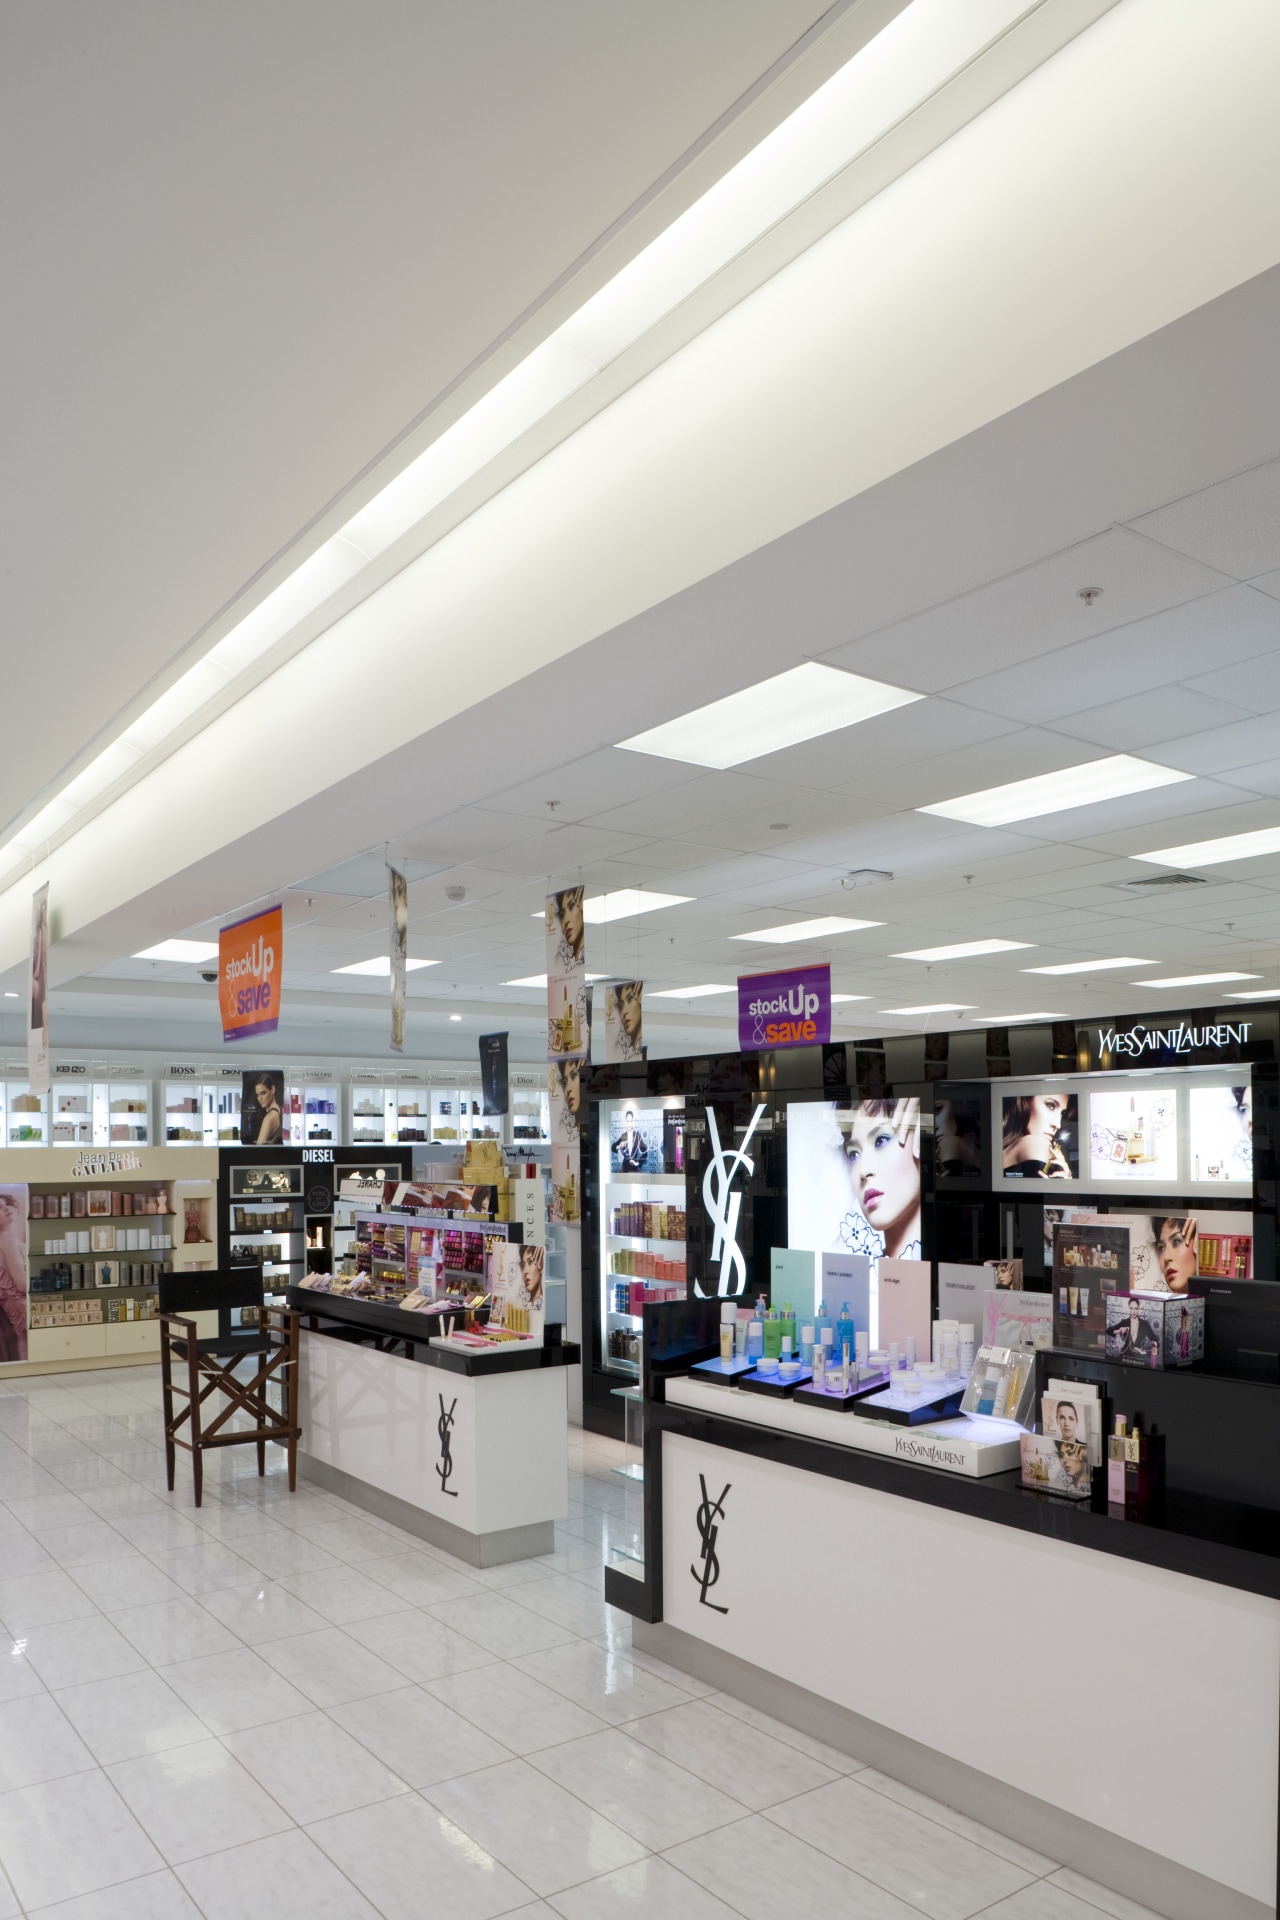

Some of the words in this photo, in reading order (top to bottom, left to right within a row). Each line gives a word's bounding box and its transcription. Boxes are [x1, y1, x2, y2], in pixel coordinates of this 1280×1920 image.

[236, 981, 271, 1015] save
[766, 1019, 817, 1044] save
[56, 1065, 86, 1074] KENZO
[170, 1066, 196, 1075] BOSS
[517, 1076, 534, 1085] Dior
[78, 1151, 106, 1164] Jean
[302, 1149, 335, 1162] DIESEL
[71, 1157, 142, 1177] GAULTIER
